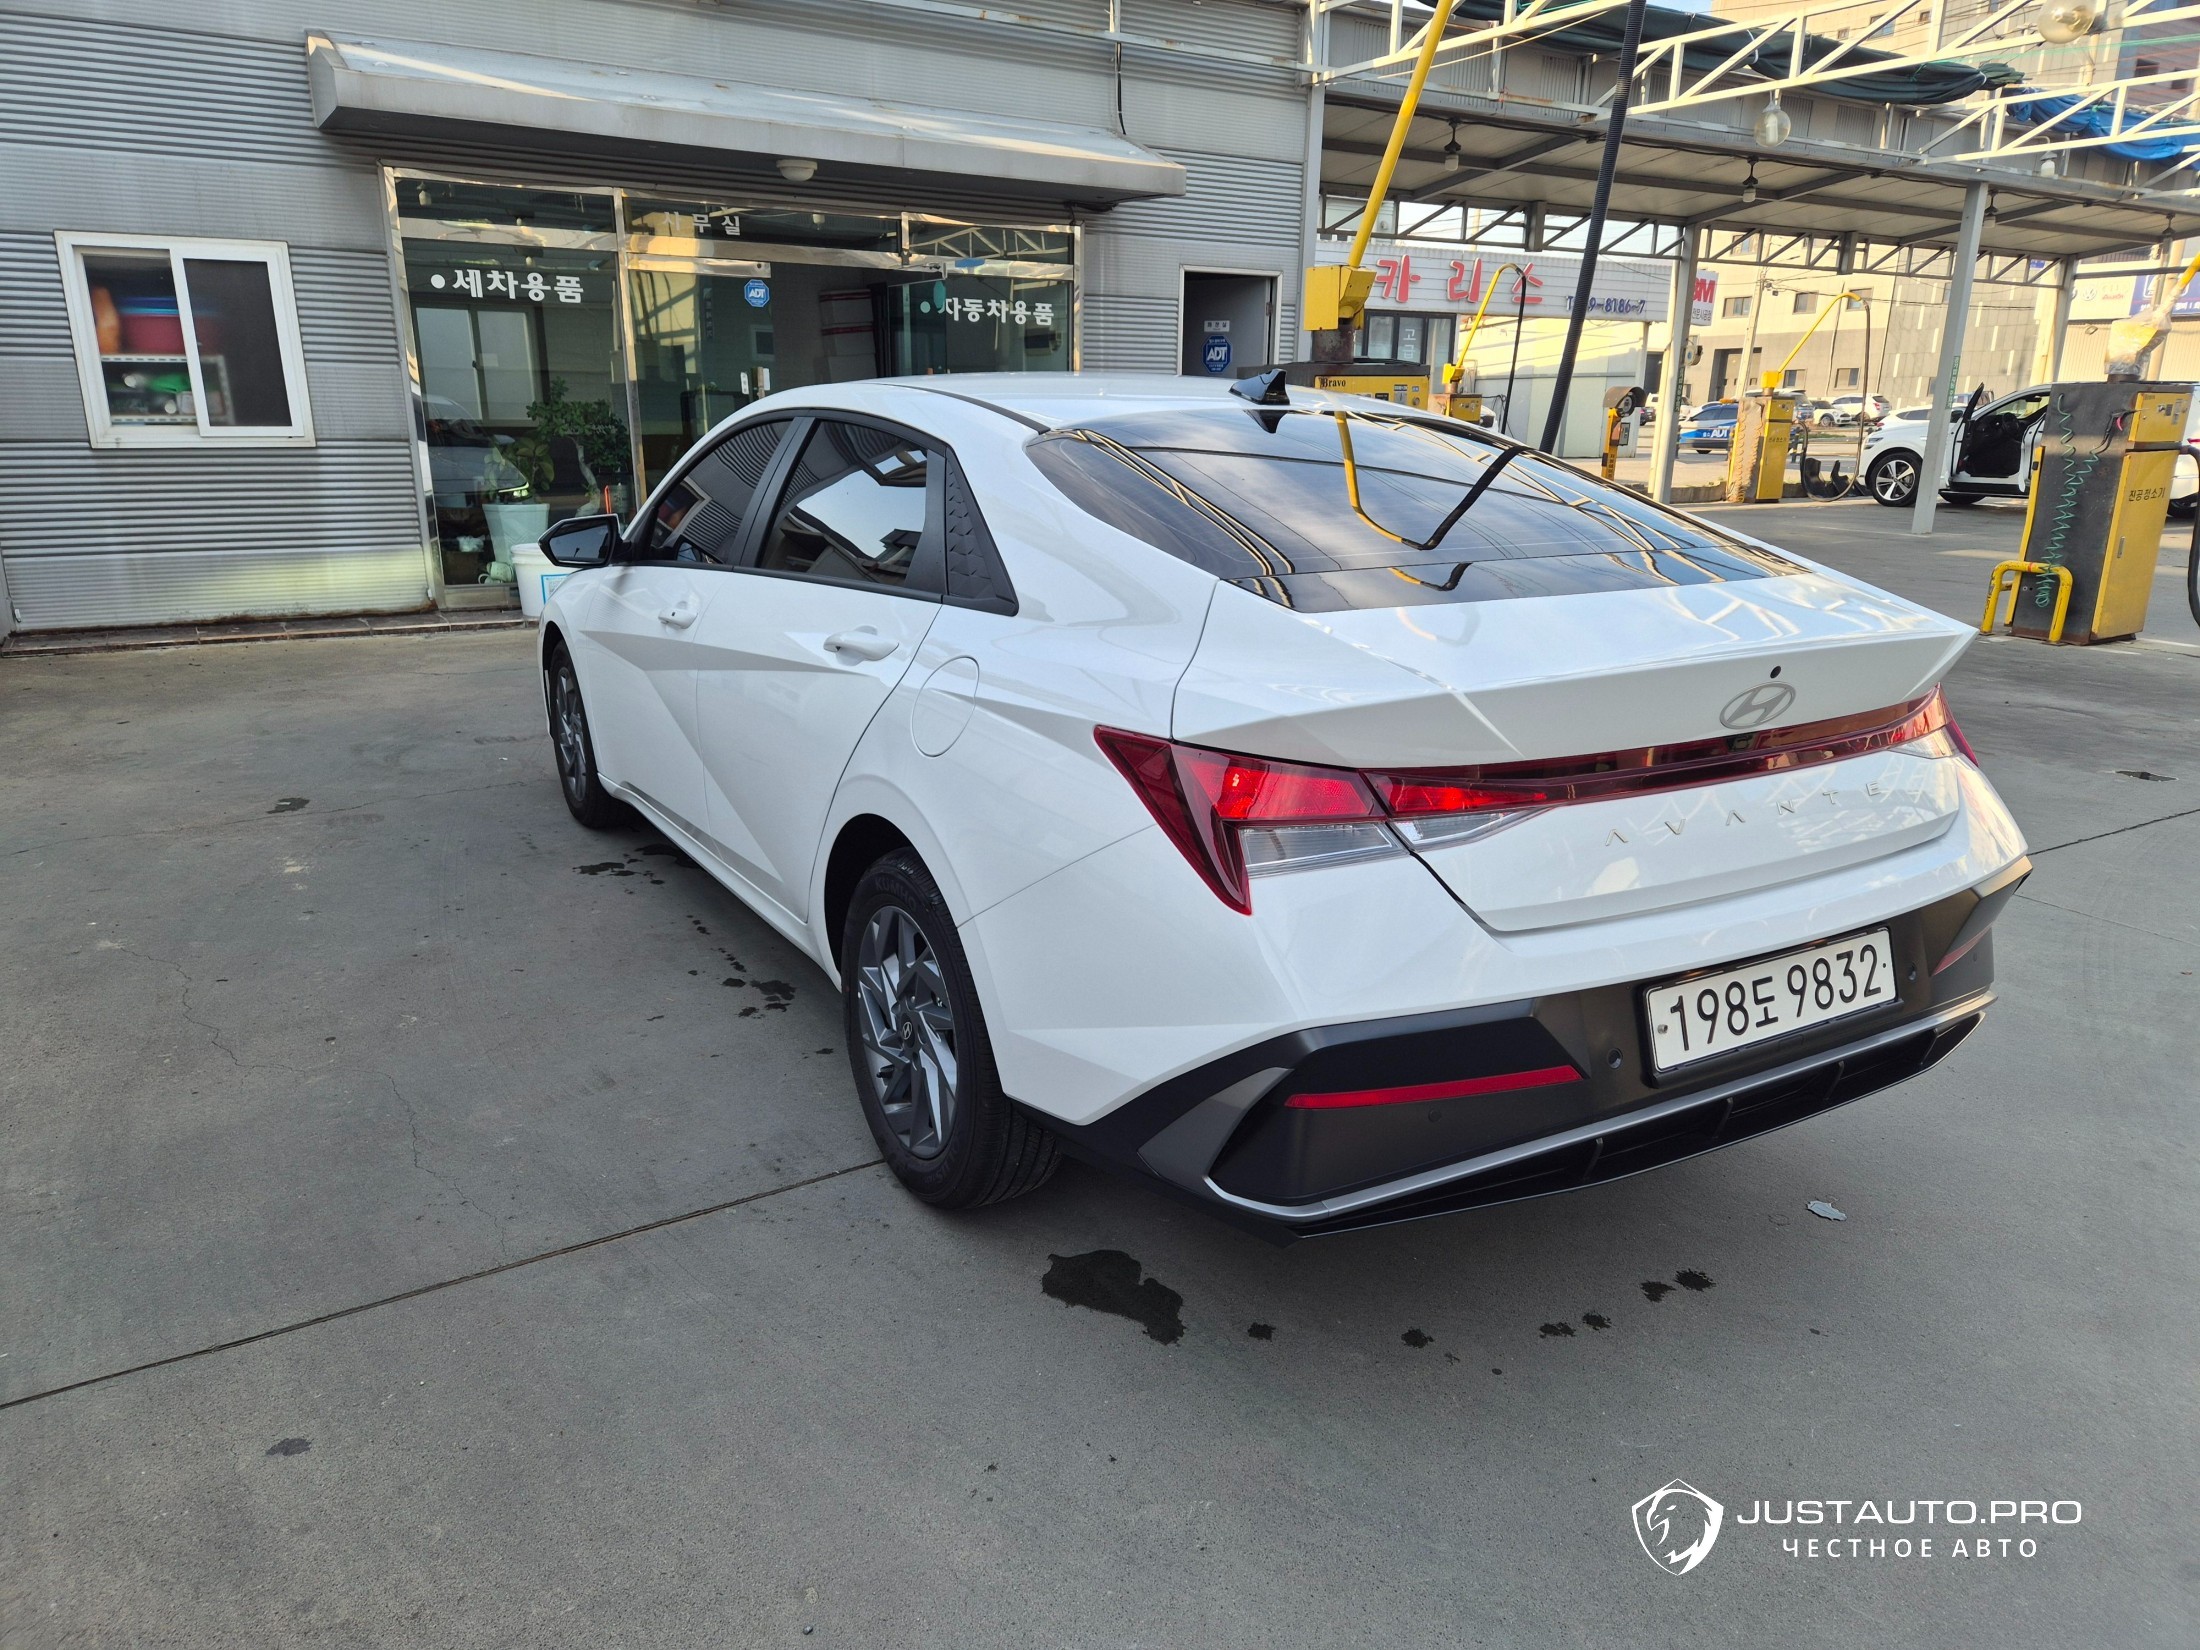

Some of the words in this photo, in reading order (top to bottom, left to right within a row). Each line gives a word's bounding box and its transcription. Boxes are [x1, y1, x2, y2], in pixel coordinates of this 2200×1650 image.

[662, 211, 741, 236] 사무실
[452, 268, 584, 304] 세차용품
[1375, 254, 1544, 304] 카리스
[748, 288, 766, 298] ADT
[938, 297, 1054, 326] 자동차용품
[1206, 346, 1228, 362] ADT
[1318, 377, 1347, 388] Bravo
[1604, 780, 1881, 847] AVANTE
